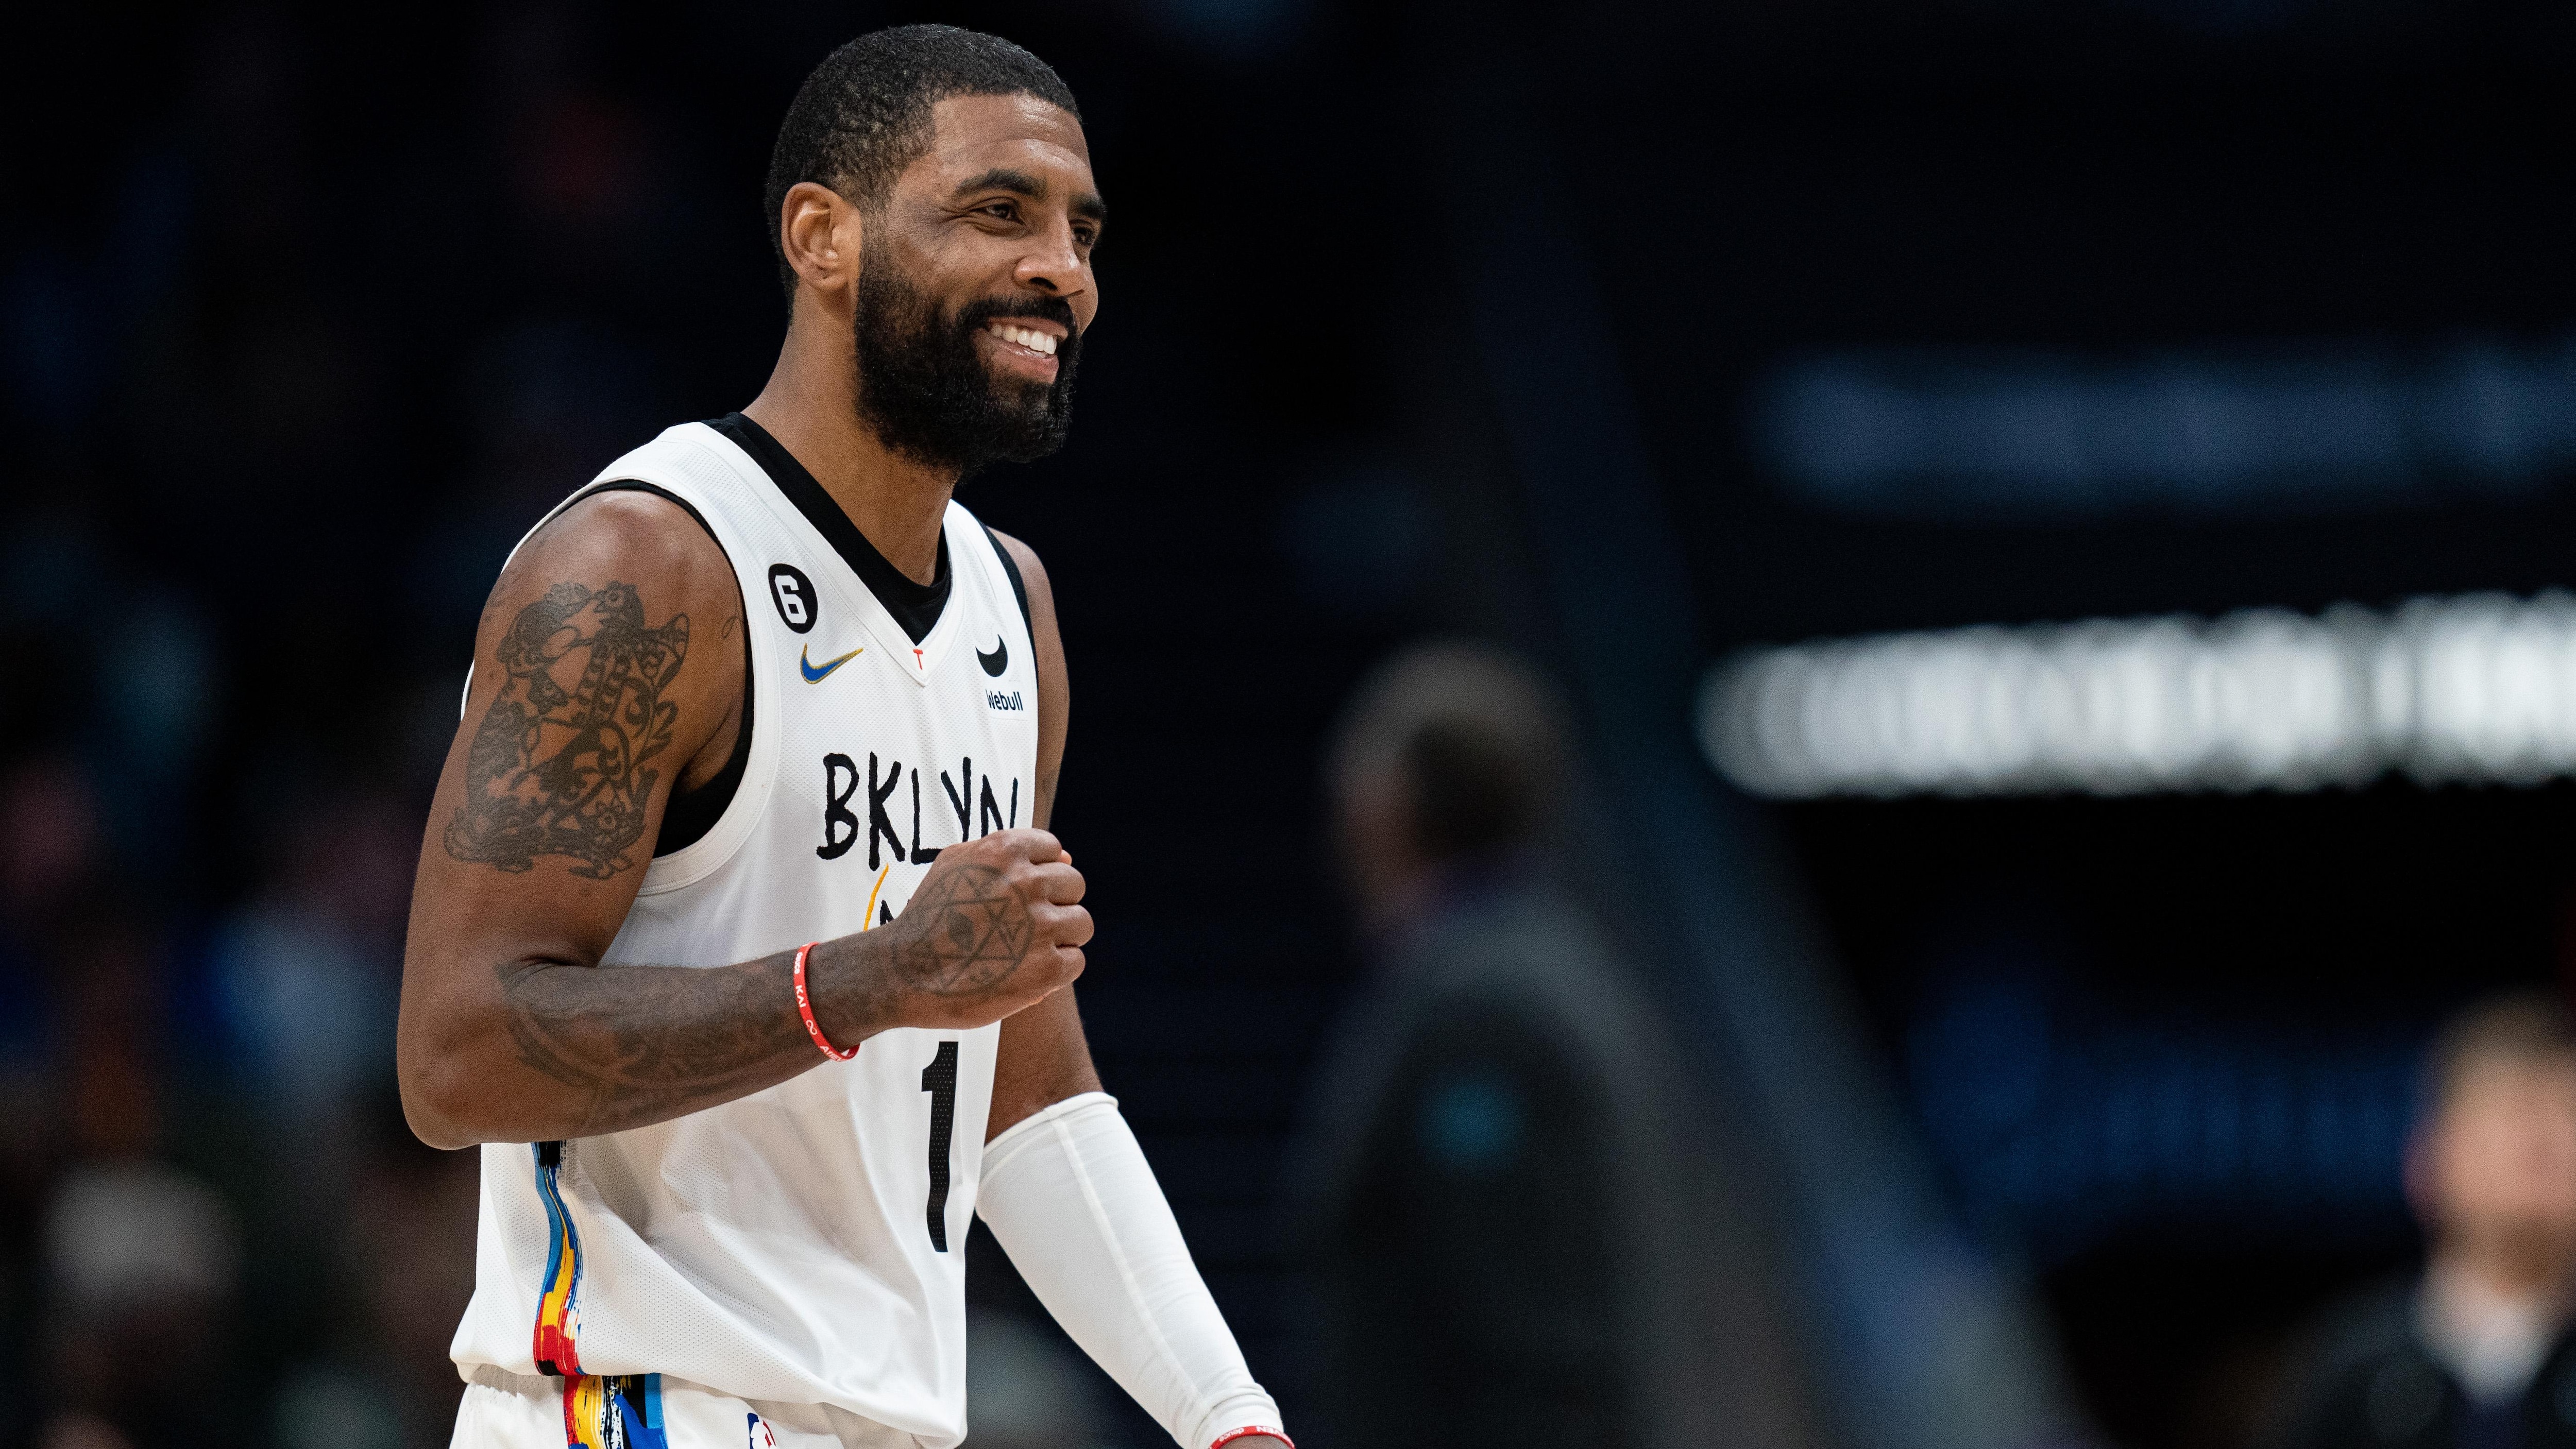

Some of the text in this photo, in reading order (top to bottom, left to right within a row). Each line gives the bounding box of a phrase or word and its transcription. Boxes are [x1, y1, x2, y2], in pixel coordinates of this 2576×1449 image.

[774, 574, 808, 624] 6
[985, 689, 1023, 711] Webull
[816, 751, 1018, 871] BKLYN
[922, 1041, 959, 1253] 1
